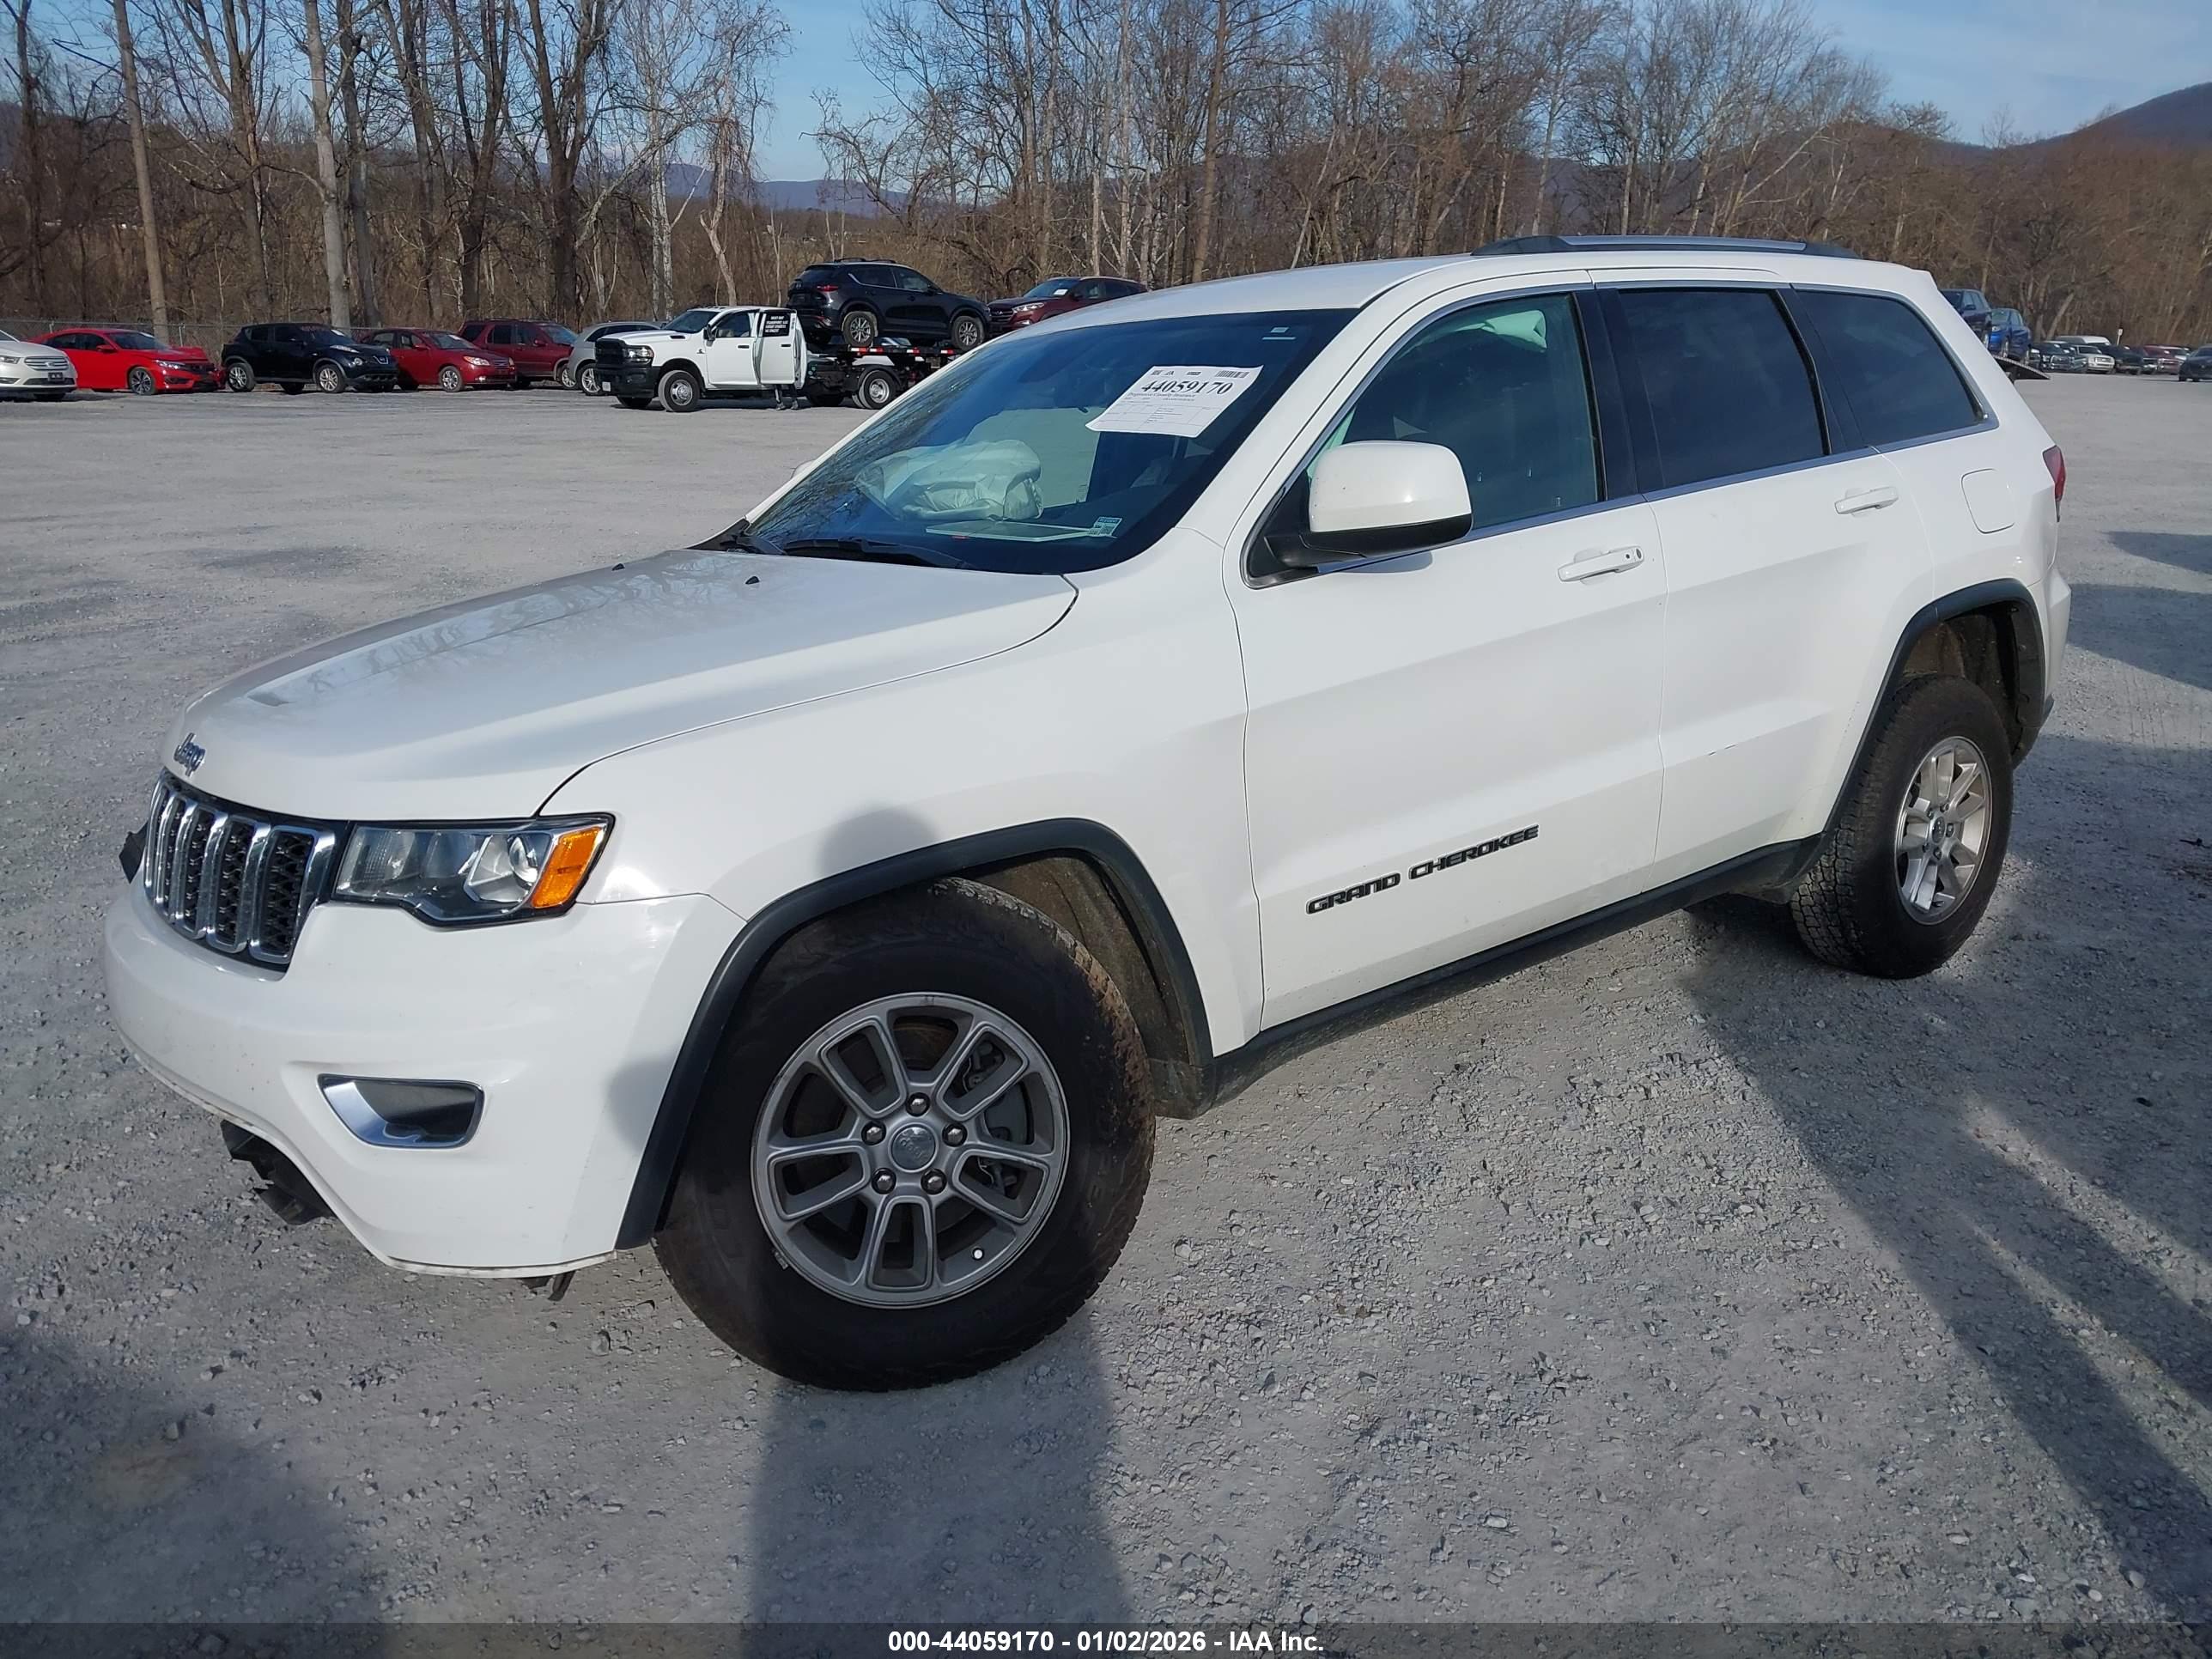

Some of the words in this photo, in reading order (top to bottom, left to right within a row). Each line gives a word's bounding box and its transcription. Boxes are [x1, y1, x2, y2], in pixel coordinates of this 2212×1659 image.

[1141, 380, 1233, 395] 44059170
[1305, 872, 1401, 915] GRAND
[1408, 823, 1539, 880] CHEROKEE
